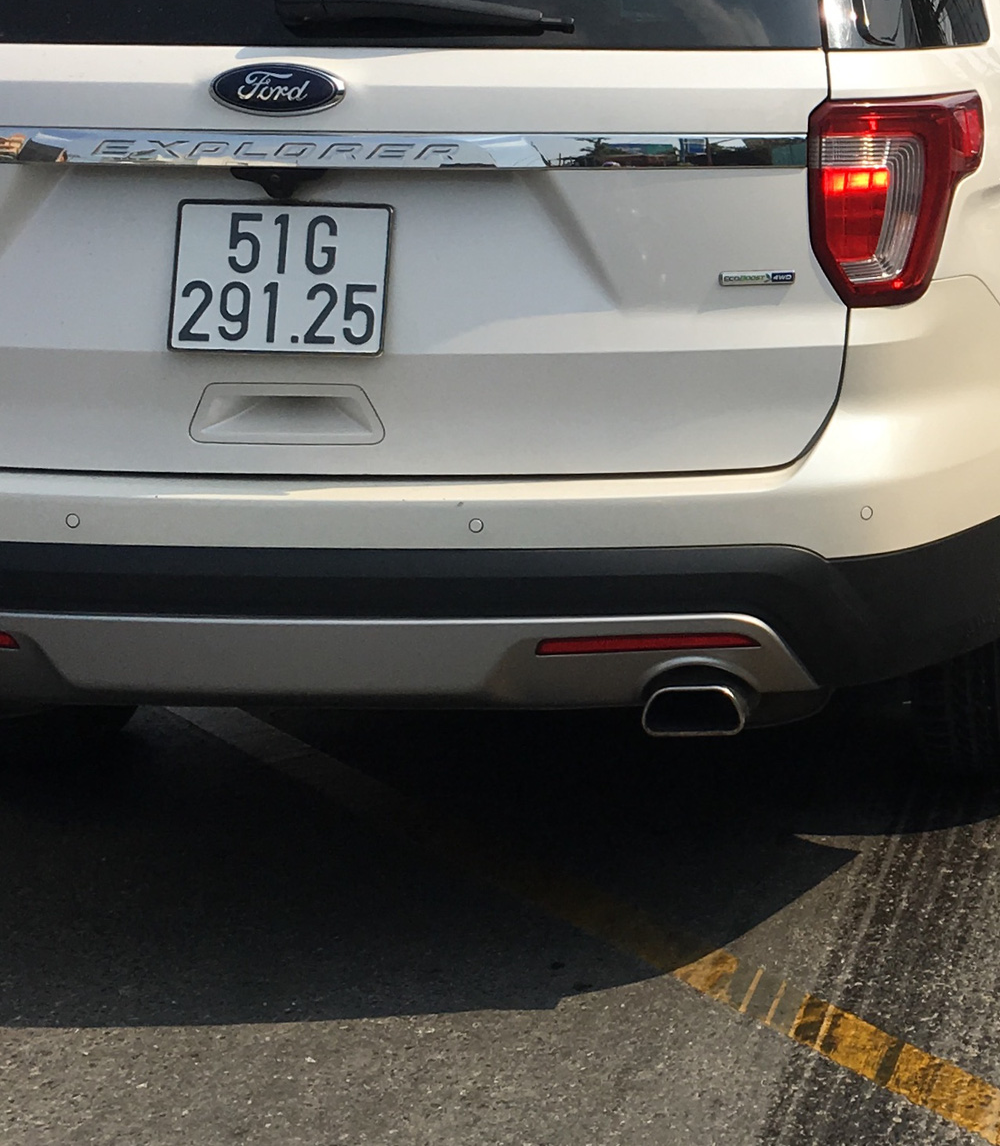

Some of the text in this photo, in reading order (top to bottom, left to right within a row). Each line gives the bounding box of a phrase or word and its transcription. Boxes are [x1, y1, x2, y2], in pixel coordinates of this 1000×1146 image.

[236, 68, 310, 104] Ford
[91, 138, 466, 164] EXPLORER
[227, 210, 339, 277] 51G
[178, 279, 377, 349] 291.25
